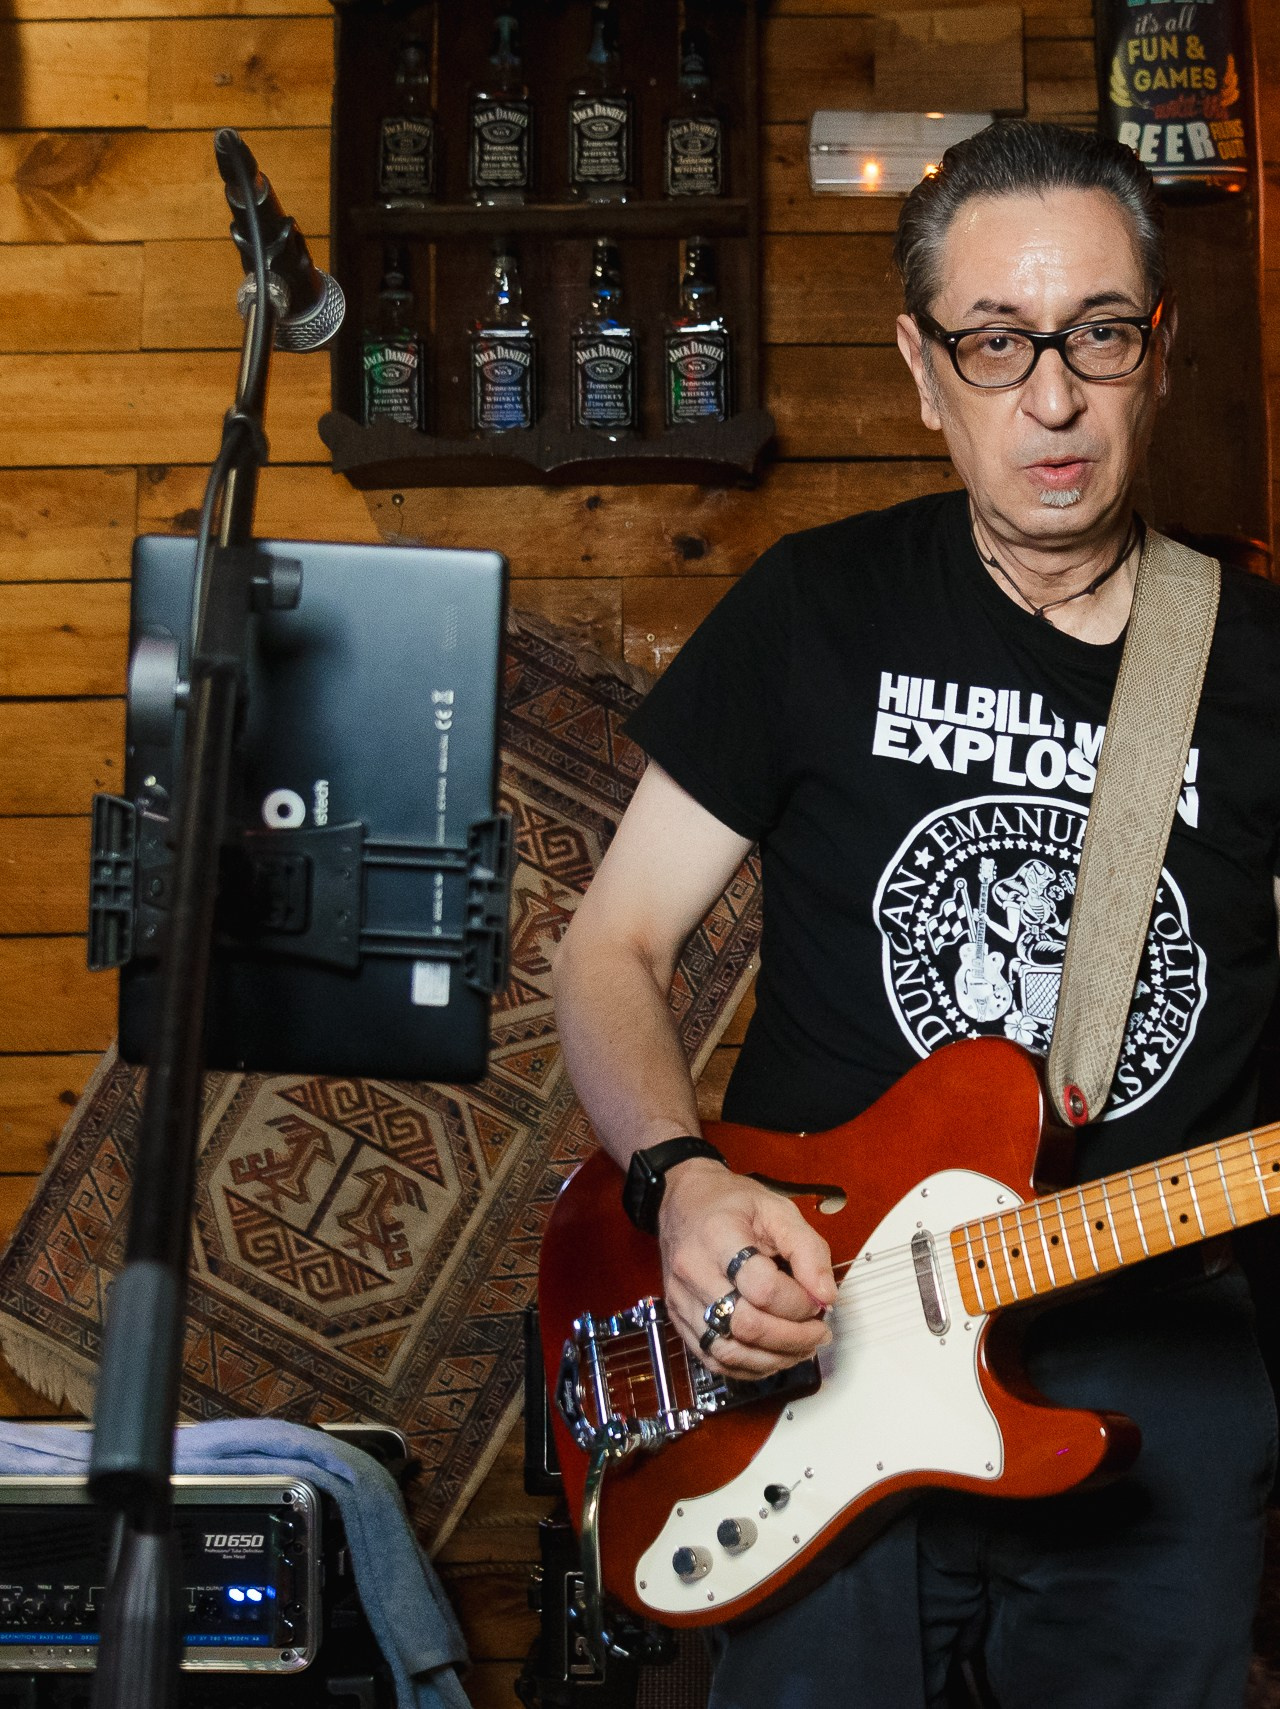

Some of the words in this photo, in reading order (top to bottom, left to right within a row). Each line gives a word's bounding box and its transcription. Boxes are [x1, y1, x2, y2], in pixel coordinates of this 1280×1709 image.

[1165, 5, 1197, 32] all
[1127, 35, 1179, 65] FUN
[1186, 35, 1206, 61] &
[1133, 66, 1218, 92] GAMES
[1118, 121, 1215, 162] BEER
[363, 353, 384, 370] JACK
[475, 350, 496, 367] JACK
[576, 347, 598, 365] JACK
[669, 345, 690, 363] JACK
[1074, 722, 1199, 783] MN
[872, 711, 1199, 828] EXPLOSN
[882, 865, 952, 1051] DUNCAN
[925, 806, 1089, 856] EMANU
[1150, 912, 1196, 1054] OLIVER
[204, 1534, 265, 1547] TD650
